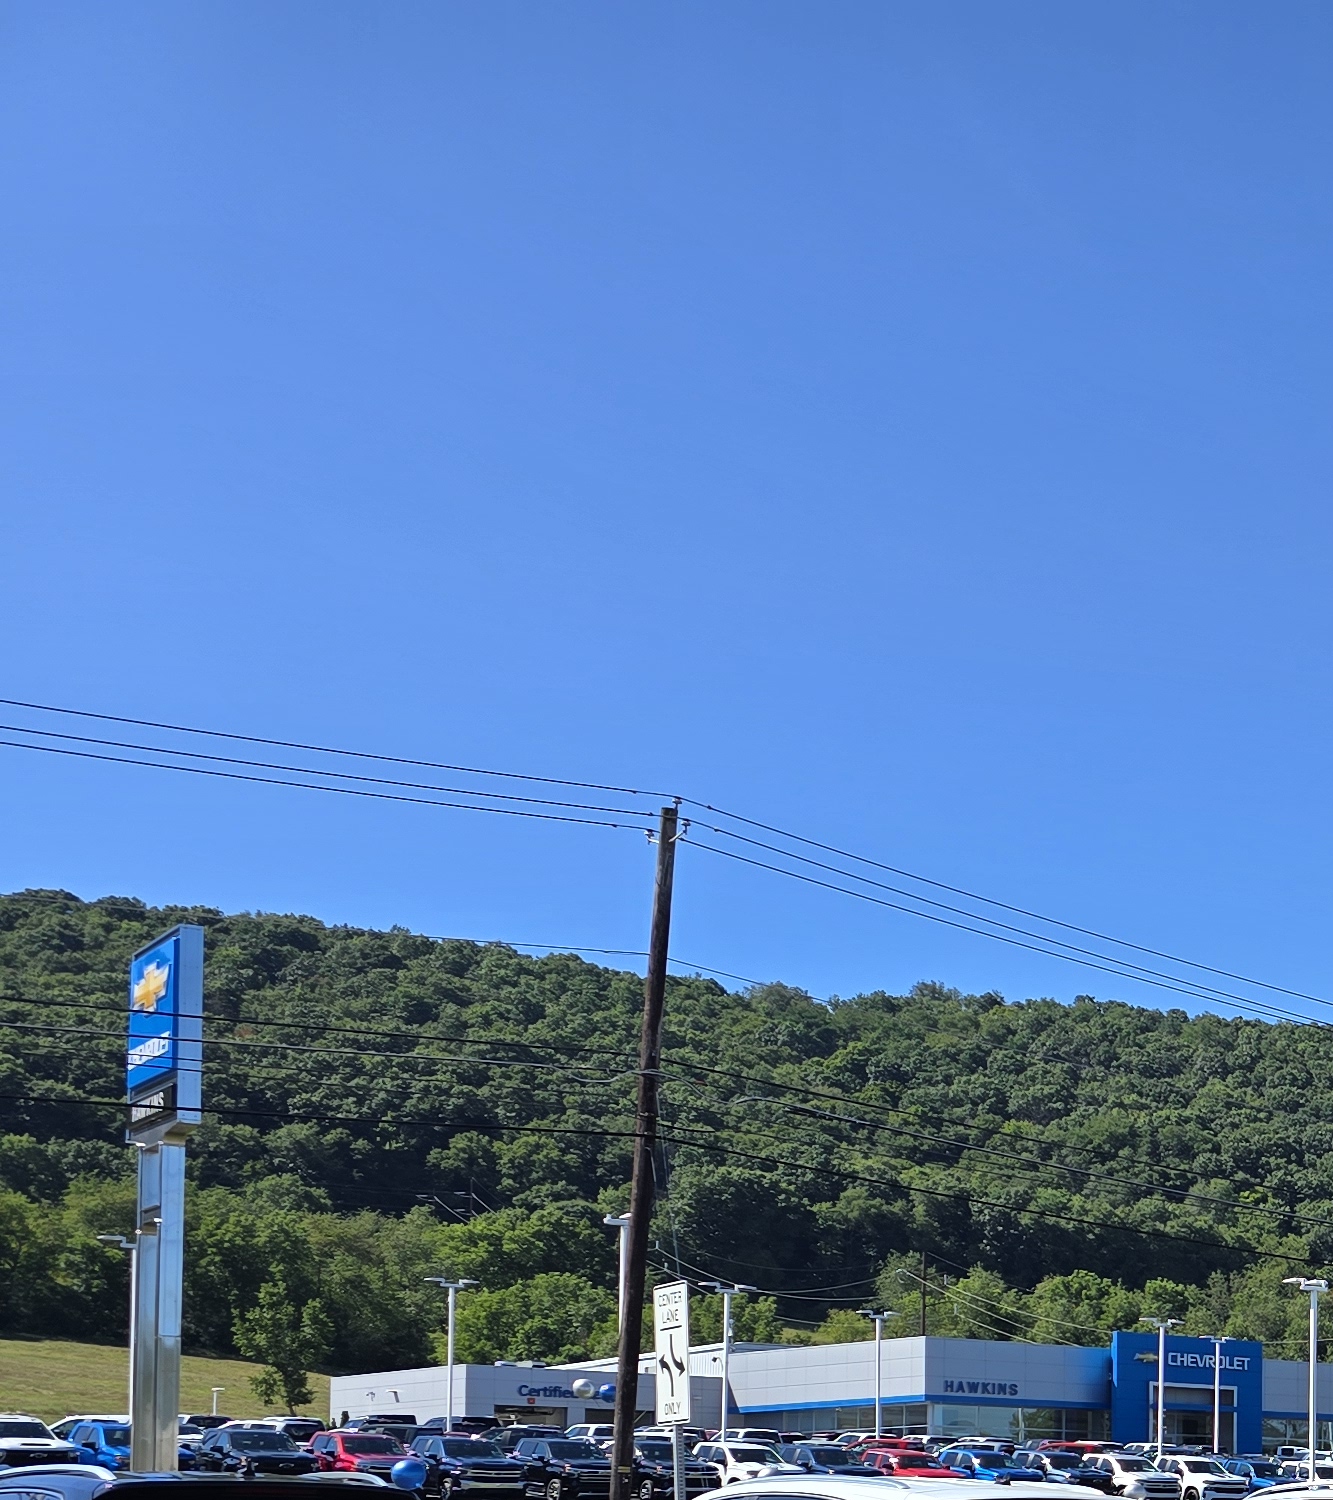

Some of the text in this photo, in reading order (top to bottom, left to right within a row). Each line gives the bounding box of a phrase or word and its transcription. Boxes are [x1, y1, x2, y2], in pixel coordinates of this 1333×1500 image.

[658, 1290, 682, 1307] CENTER
[662, 1308, 679, 1324] LANE
[1167, 1352, 1251, 1371] CHEVROLET
[943, 1380, 1019, 1396] HAWKINS
[664, 1402, 682, 1416] ONLY
